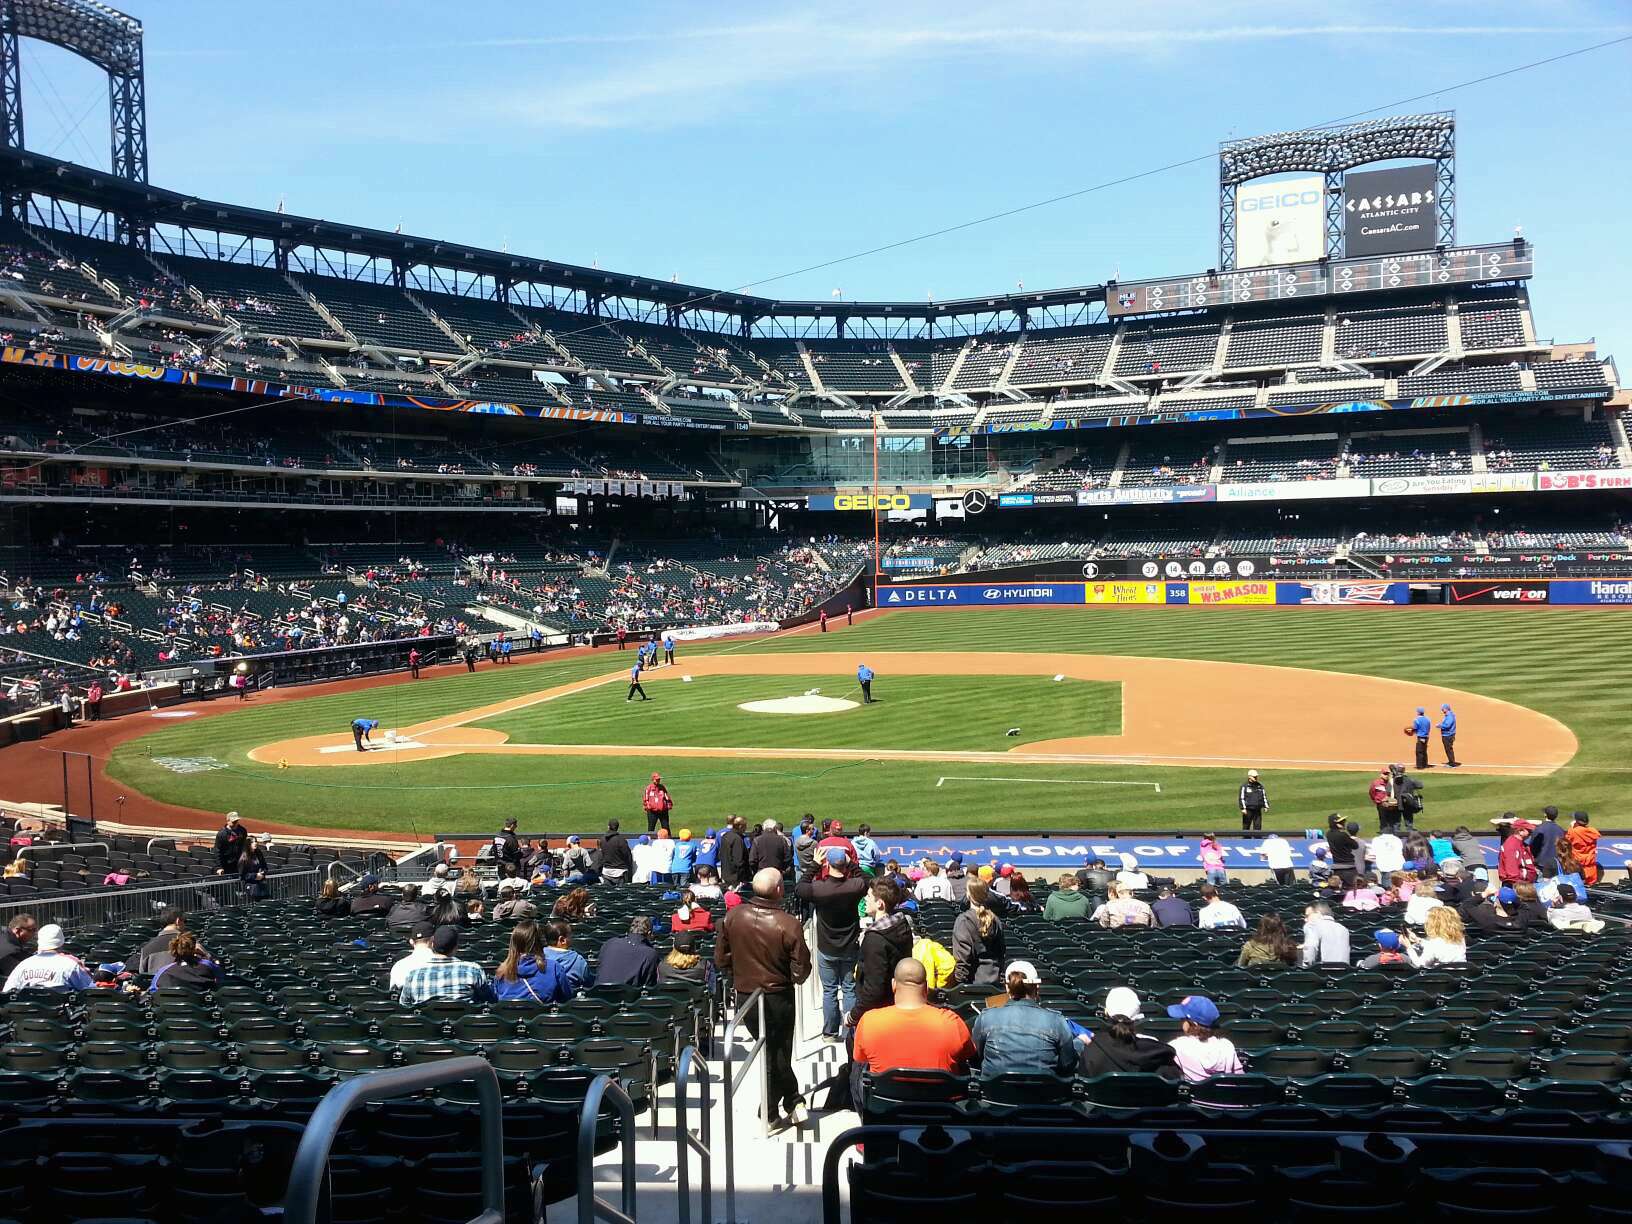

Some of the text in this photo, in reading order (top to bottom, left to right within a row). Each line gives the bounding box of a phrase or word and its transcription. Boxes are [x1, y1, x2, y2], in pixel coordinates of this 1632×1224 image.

[1241, 191, 1320, 211] GEICO
[1346, 190, 1435, 211] CAESARS
[1361, 209, 1399, 218] ATLANTIC
[1361, 223, 1420, 235] CaesarsAC.com
[1541, 474, 1597, 489] BOB'S
[834, 495, 910, 510] GEICO
[905, 590, 957, 600] DELTA
[1003, 589, 1052, 598] HYUNDAI
[1113, 585, 1136, 594] Wheat
[1170, 589, 1186, 597] 358
[1493, 587, 1546, 601] verizon
[990, 845, 1120, 856] HOME
[1134, 846, 1190, 856] OF
[932, 885, 941, 898] 2
